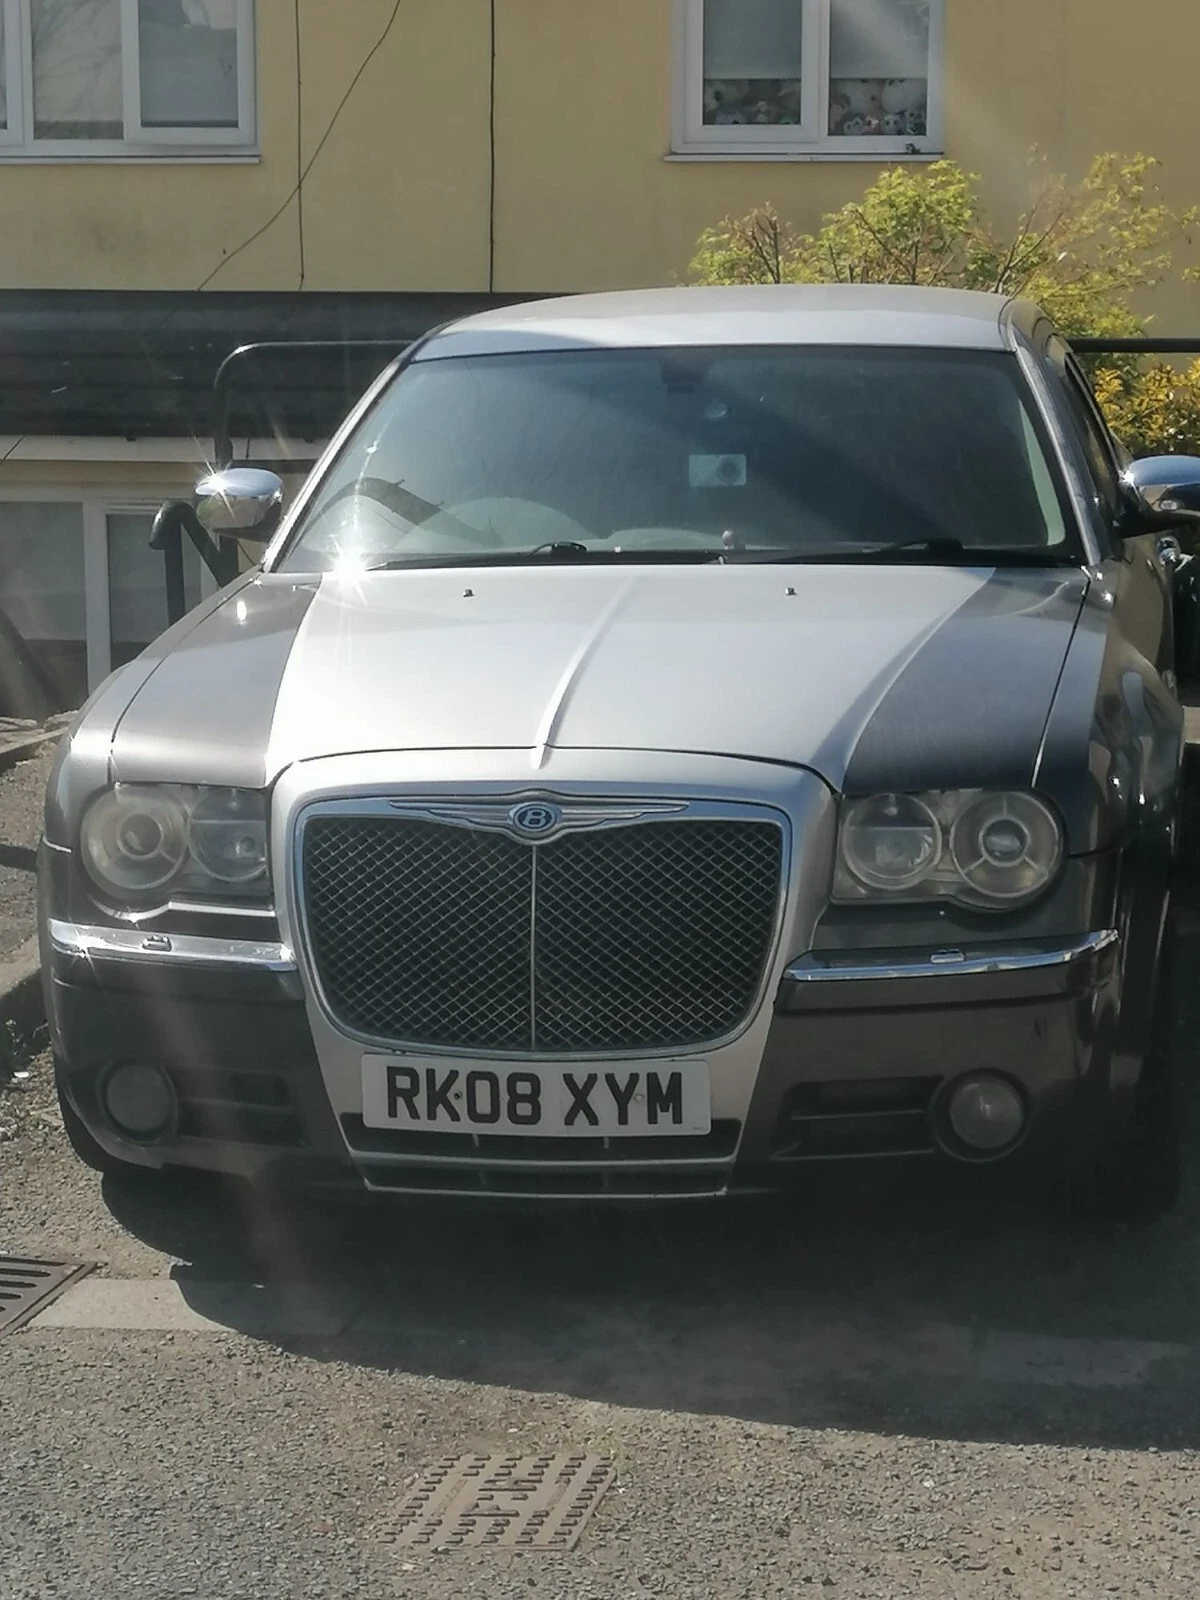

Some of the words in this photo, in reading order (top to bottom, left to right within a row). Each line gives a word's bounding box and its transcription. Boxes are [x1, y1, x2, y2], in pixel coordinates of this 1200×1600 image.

[524, 810, 550, 827] B
[387, 1066, 541, 1125] RK08
[563, 1072, 683, 1126] XYM
